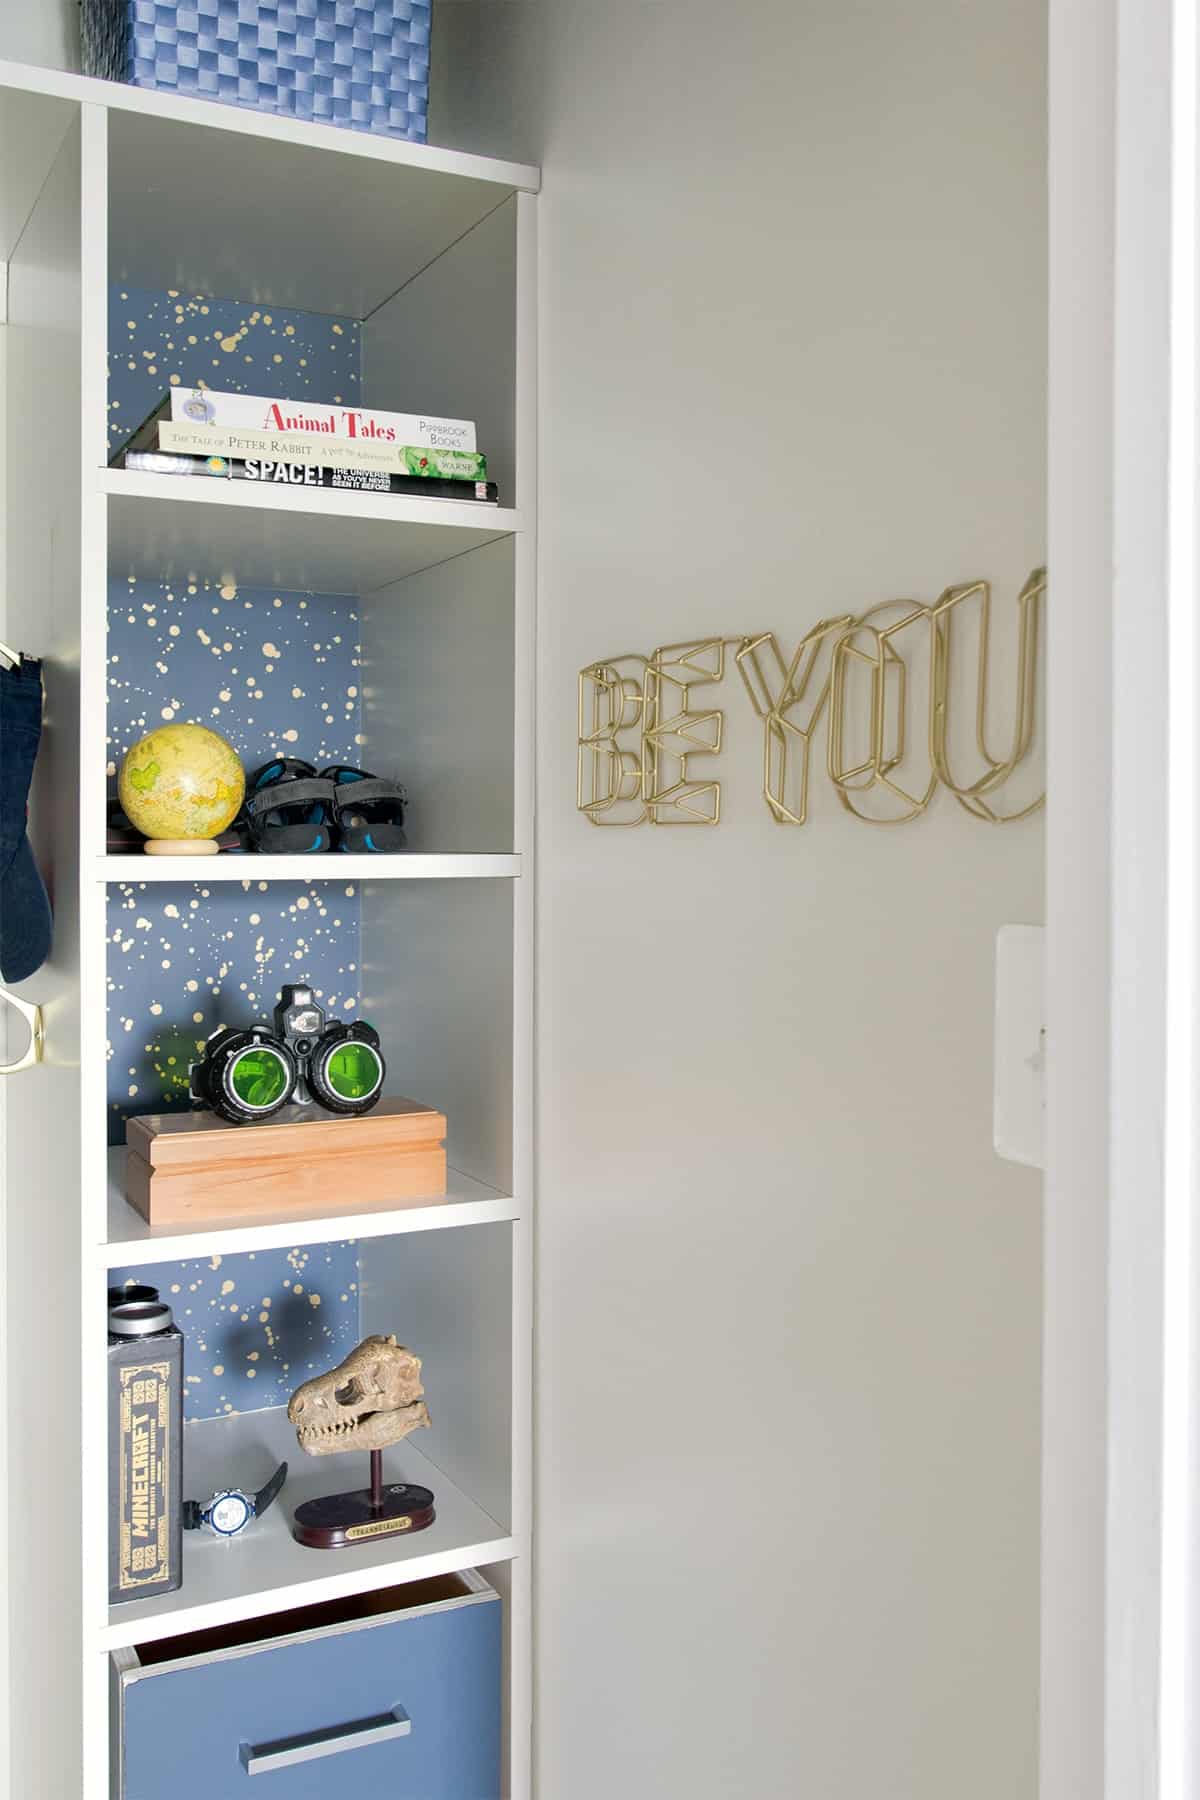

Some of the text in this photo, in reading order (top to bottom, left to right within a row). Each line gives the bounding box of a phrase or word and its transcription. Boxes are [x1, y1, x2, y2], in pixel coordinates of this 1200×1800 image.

[262, 403, 396, 440] Animal Tales
[228, 436, 267, 450] PETER
[270, 440, 313, 455] RABBIT
[244, 459, 324, 486] SPACE!
[577, 566, 1049, 827] BE YOU
[131, 1412, 149, 1538] MINECRAFT
